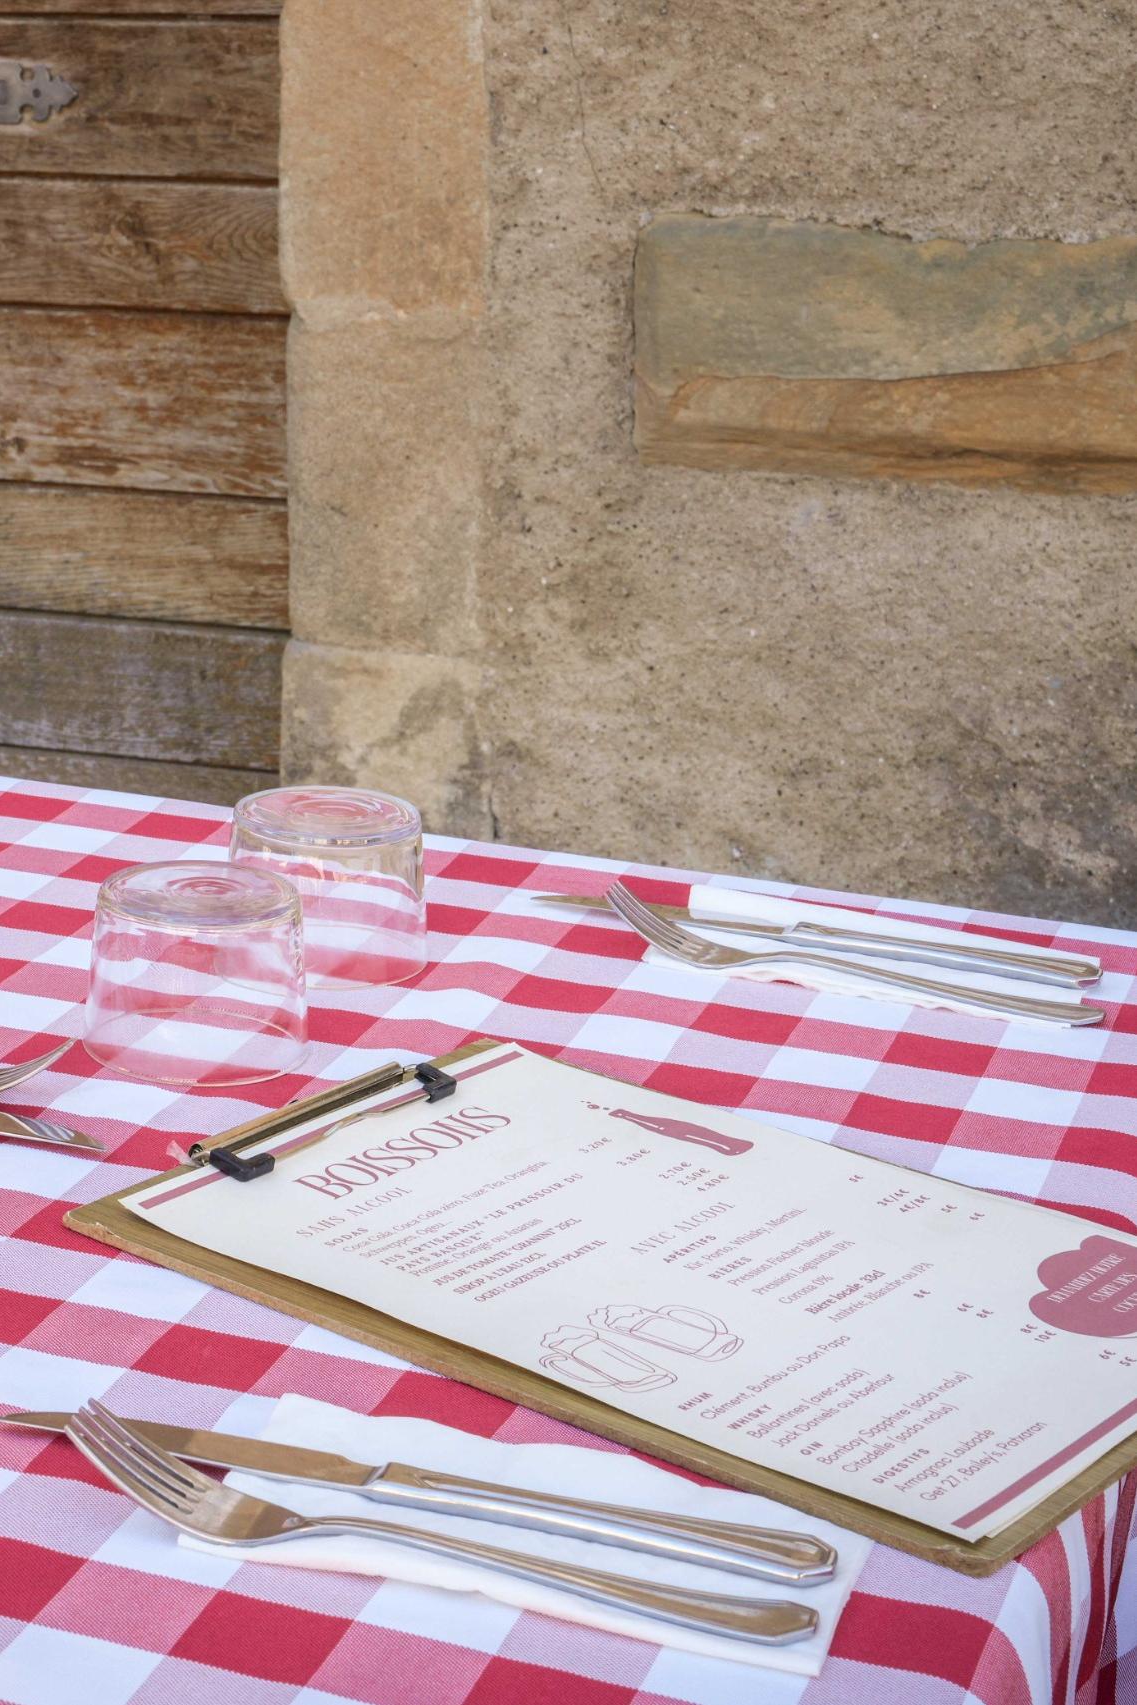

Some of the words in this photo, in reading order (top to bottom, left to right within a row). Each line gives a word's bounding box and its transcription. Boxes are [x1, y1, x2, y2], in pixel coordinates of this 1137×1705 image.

[291, 1106, 512, 1199] BOISSONS
[344, 1187, 413, 1216] ALCOOL
[416, 1210, 443, 1220] Cola
[940, 1205, 958, 1213] 5€
[378, 1254, 407, 1265] JUS
[406, 1220, 486, 1255] ARTISANAUX
[505, 1183, 566, 1210] PRESSOIR
[562, 1173, 584, 1183] DU
[630, 1232, 677, 1255] AVEC
[673, 1202, 736, 1232] ALCOOL
[323, 1228, 369, 1247] SODAS
[451, 1242, 494, 1259] Orange
[489, 1235, 510, 1243] ou
[395, 1256, 431, 1271] PAYS
[431, 1275, 456, 1286] JUS
[450, 1268, 471, 1277] DE
[464, 1250, 513, 1270] TOMATE
[553, 1218, 583, 1230] 25CL
[726, 1264, 774, 1286] Pression
[764, 1246, 805, 1265] Fischer
[796, 1230, 836, 1247] blonde
[502, 1266, 552, 1288] GAZEUSE
[546, 1259, 566, 1268] OU
[560, 1245, 597, 1261] PLATE
[751, 1273, 800, 1295] Pression
[790, 1249, 840, 1274] Lagunitas
[831, 1240, 856, 1251] IPA
[452, 1278, 487, 1294] SIROP
[778, 1283, 819, 1304] Corona
[828, 1283, 864, 1300] locale
[862, 1280, 906, 1301] Blanche
[900, 1272, 919, 1280] ou
[910, 1263, 935, 1273] IPA
[956, 1303, 975, 1312] 6€
[975, 1309, 995, 1318] 8€
[1019, 1324, 1038, 1333] 8€
[1033, 1330, 1058, 1342] 10€
[1098, 1350, 1117, 1359] 6€
[1118, 1357, 1137, 1366] 5€
[745, 1371, 790, 1392] Bumbu
[785, 1363, 804, 1372] ou
[795, 1351, 826, 1364] Don
[677, 1392, 714, 1411] RHUM
[745, 1405, 811, 1439] Ballantines
[800, 1387, 839, 1406] (avec
[834, 1368, 872, 1388] soda)
[771, 1431, 802, 1447] Jack
[793, 1408, 840, 1432] Daniels
[836, 1399, 856, 1408] ou
[848, 1374, 896, 1400] Aberlour
[726, 1404, 772, 1429] WHISKY
[815, 1436, 870, 1465] Bombay
[857, 1409, 911, 1438] Sapphire
[902, 1392, 940, 1410] (soda
[933, 1371, 974, 1392] inclus)
[799, 1441, 824, 1455] GIN
[841, 1443, 896, 1472] Citadelle
[886, 1424, 926, 1444] (soda
[918, 1403, 960, 1425] inclus)
[871, 1449, 931, 1484] DIGESTIFS
[893, 1458, 953, 1492] Armagnac
[943, 1430, 996, 1458] Laubade
[919, 1487, 949, 1500] Get
[995, 1422, 1048, 1450] Patxaran
